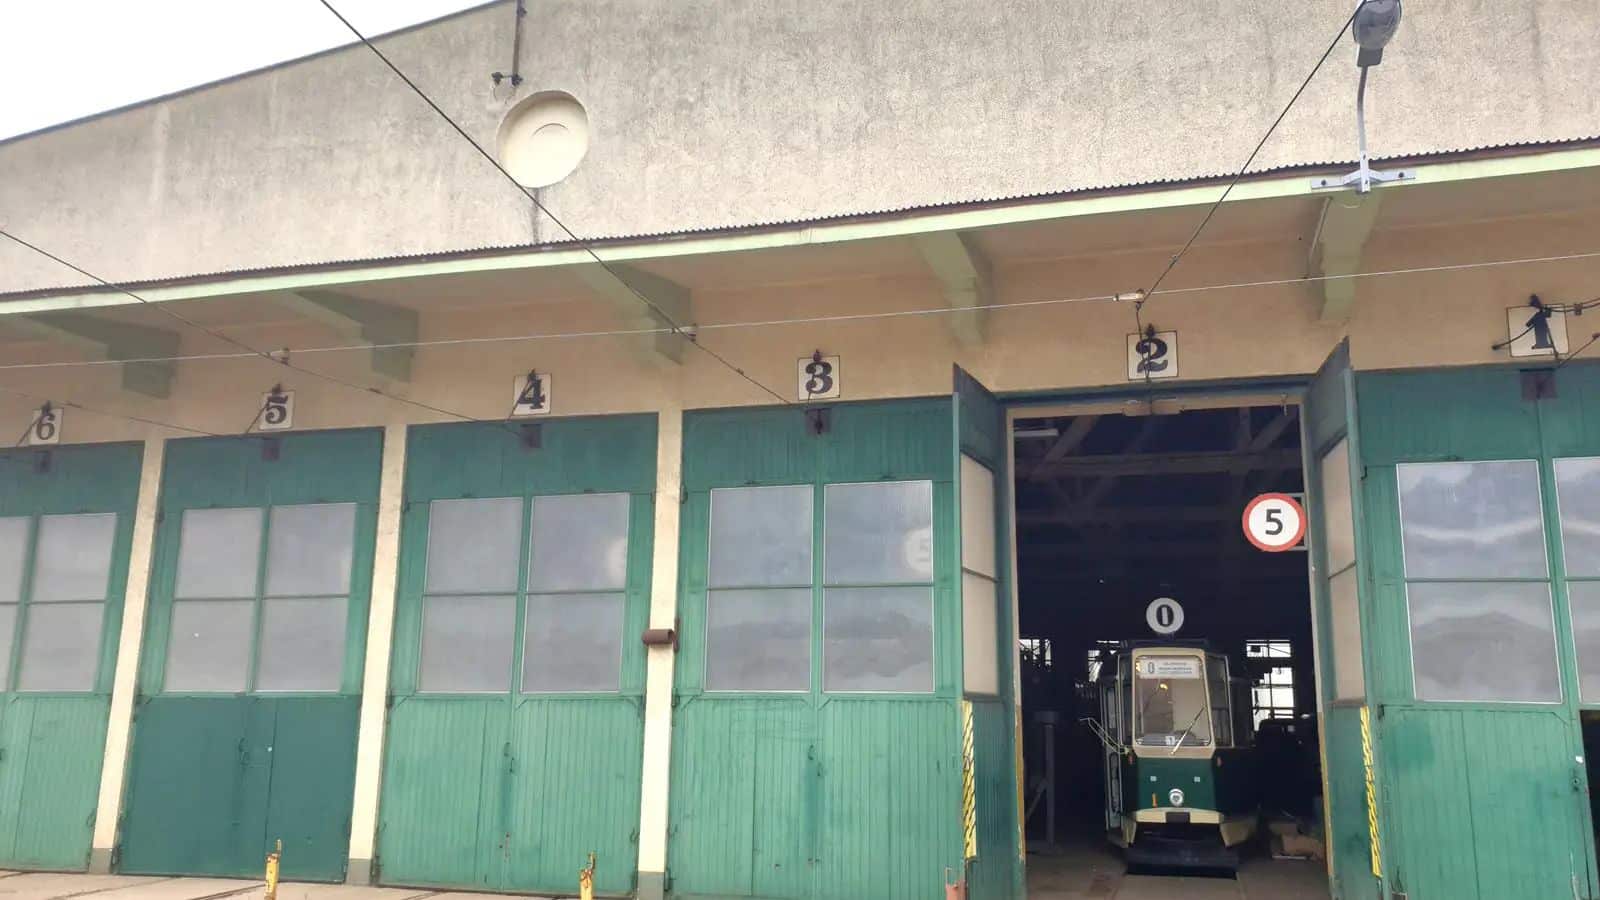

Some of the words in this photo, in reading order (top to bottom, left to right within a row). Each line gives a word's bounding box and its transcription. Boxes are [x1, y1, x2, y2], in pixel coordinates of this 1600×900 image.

[1525, 308, 1555, 350] 1
[1136, 338, 1168, 374] 2
[805, 361, 833, 394] 3
[517, 377, 545, 410] 4
[265, 395, 288, 425] 5
[35, 412, 56, 440] 6
[1265, 508, 1283, 536] 5
[1156, 604, 1174, 627] 0
